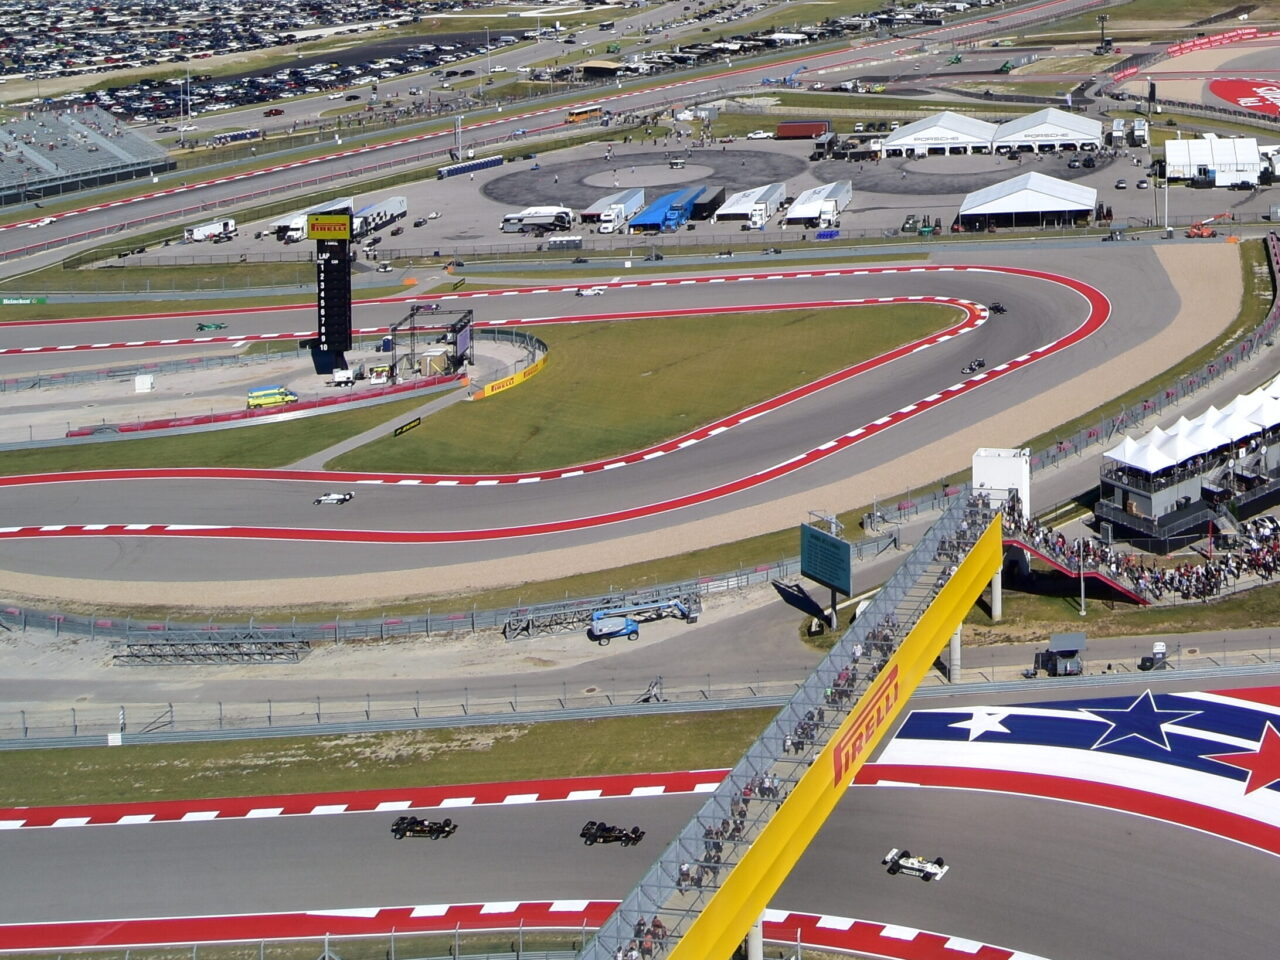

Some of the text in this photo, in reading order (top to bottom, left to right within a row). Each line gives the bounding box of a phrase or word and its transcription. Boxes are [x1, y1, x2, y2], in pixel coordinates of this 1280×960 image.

[311, 223, 346, 232] PIRELLI
[491, 377, 514, 392] PIRELLI
[833, 664, 899, 788] PIRELLI
